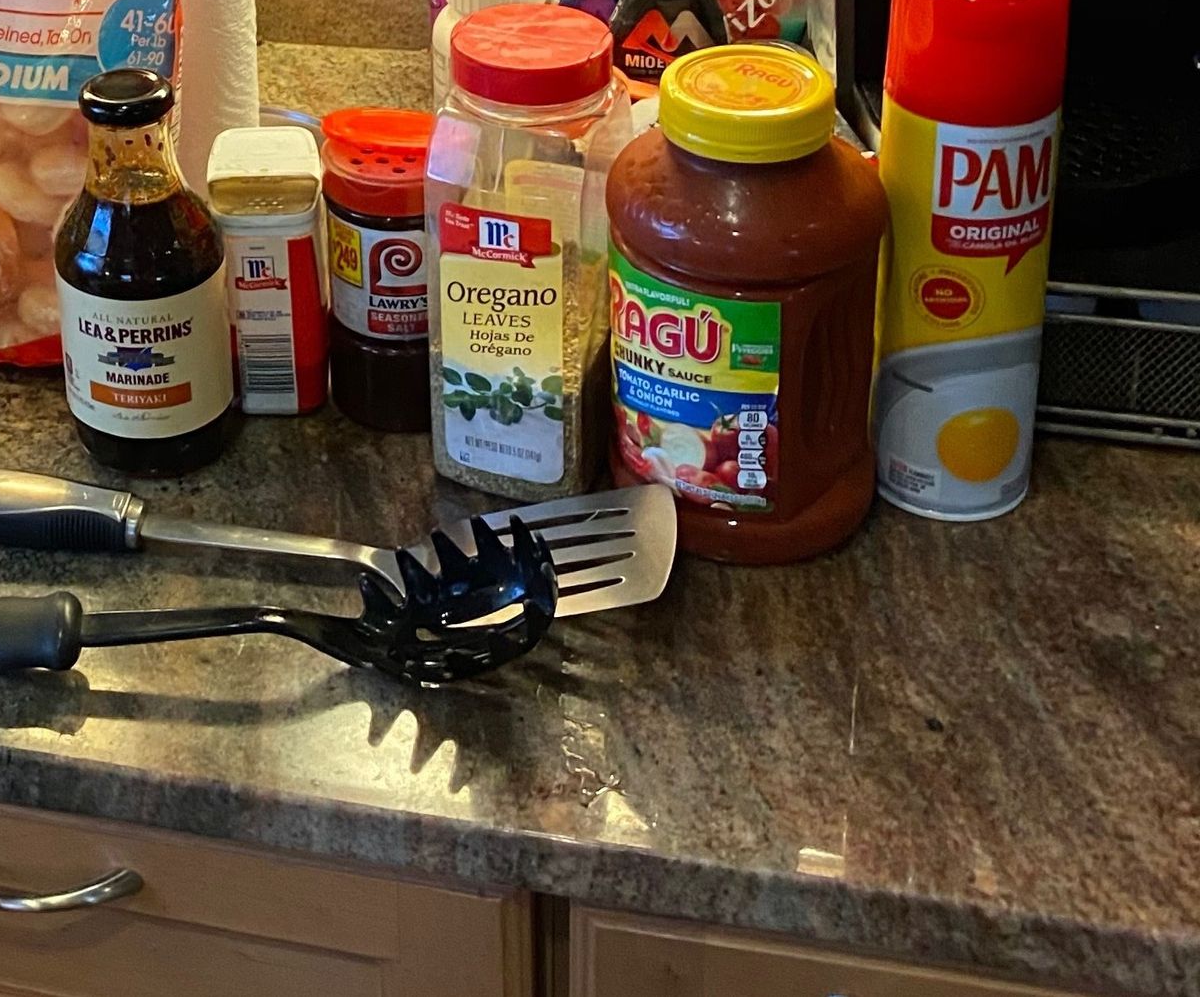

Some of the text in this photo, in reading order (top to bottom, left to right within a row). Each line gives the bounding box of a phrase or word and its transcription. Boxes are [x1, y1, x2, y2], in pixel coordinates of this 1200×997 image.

[131, 33, 149, 47] Per
[126, 50, 165, 66] 61-90
[939, 135, 1052, 211] PAM
[949, 218, 1040, 241] ORIGINAL
[472, 246, 527, 263] McCormick
[447, 281, 557, 312] Oregano
[935, 288, 953, 297] NO
[92, 312, 174, 325] ALL NATURAL
[370, 312, 427, 323] SEASONE
[462, 312, 531, 328] LEAVES
[387, 323, 416, 333] SALT
[470, 329, 535, 343] Hojas De
[470, 341, 532, 357] Orégano
[614, 341, 713, 384] CHUNKY SAUCE
[106, 371, 170, 385] MARINADE
[618, 367, 700, 403] TOMATO, GARLIC
[113, 392, 167, 404] TERIYAKI
[629, 385, 673, 409] & ONION
[746, 412, 760, 423] 80
